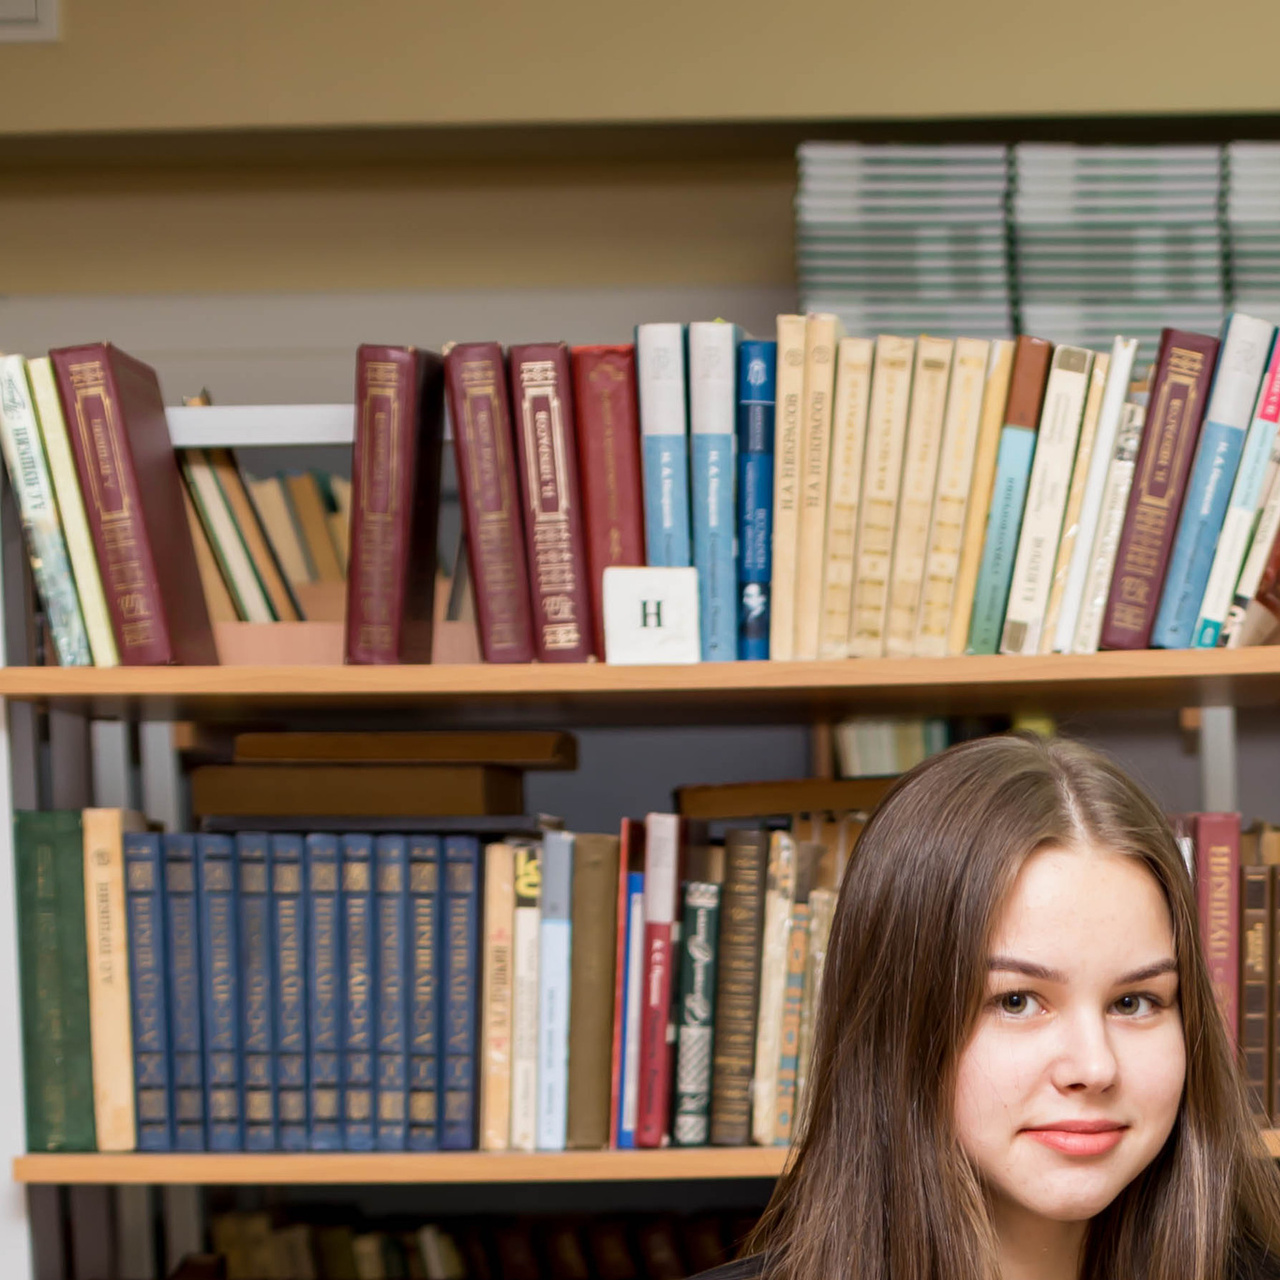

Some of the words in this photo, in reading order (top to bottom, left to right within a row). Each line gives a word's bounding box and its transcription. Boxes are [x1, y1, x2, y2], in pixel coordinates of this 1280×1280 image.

[12, 427, 39, 486] ПУШКИН
[536, 411, 553, 481] НЕКРАСОВ
[782, 393, 799, 478] НЕКРАСОВ
[809, 391, 825, 475] НЕКРАСОВ
[639, 600, 663, 628] Н
[96, 882, 112, 956] ПУШКИН
[1209, 846, 1231, 959] ПУШКИН
